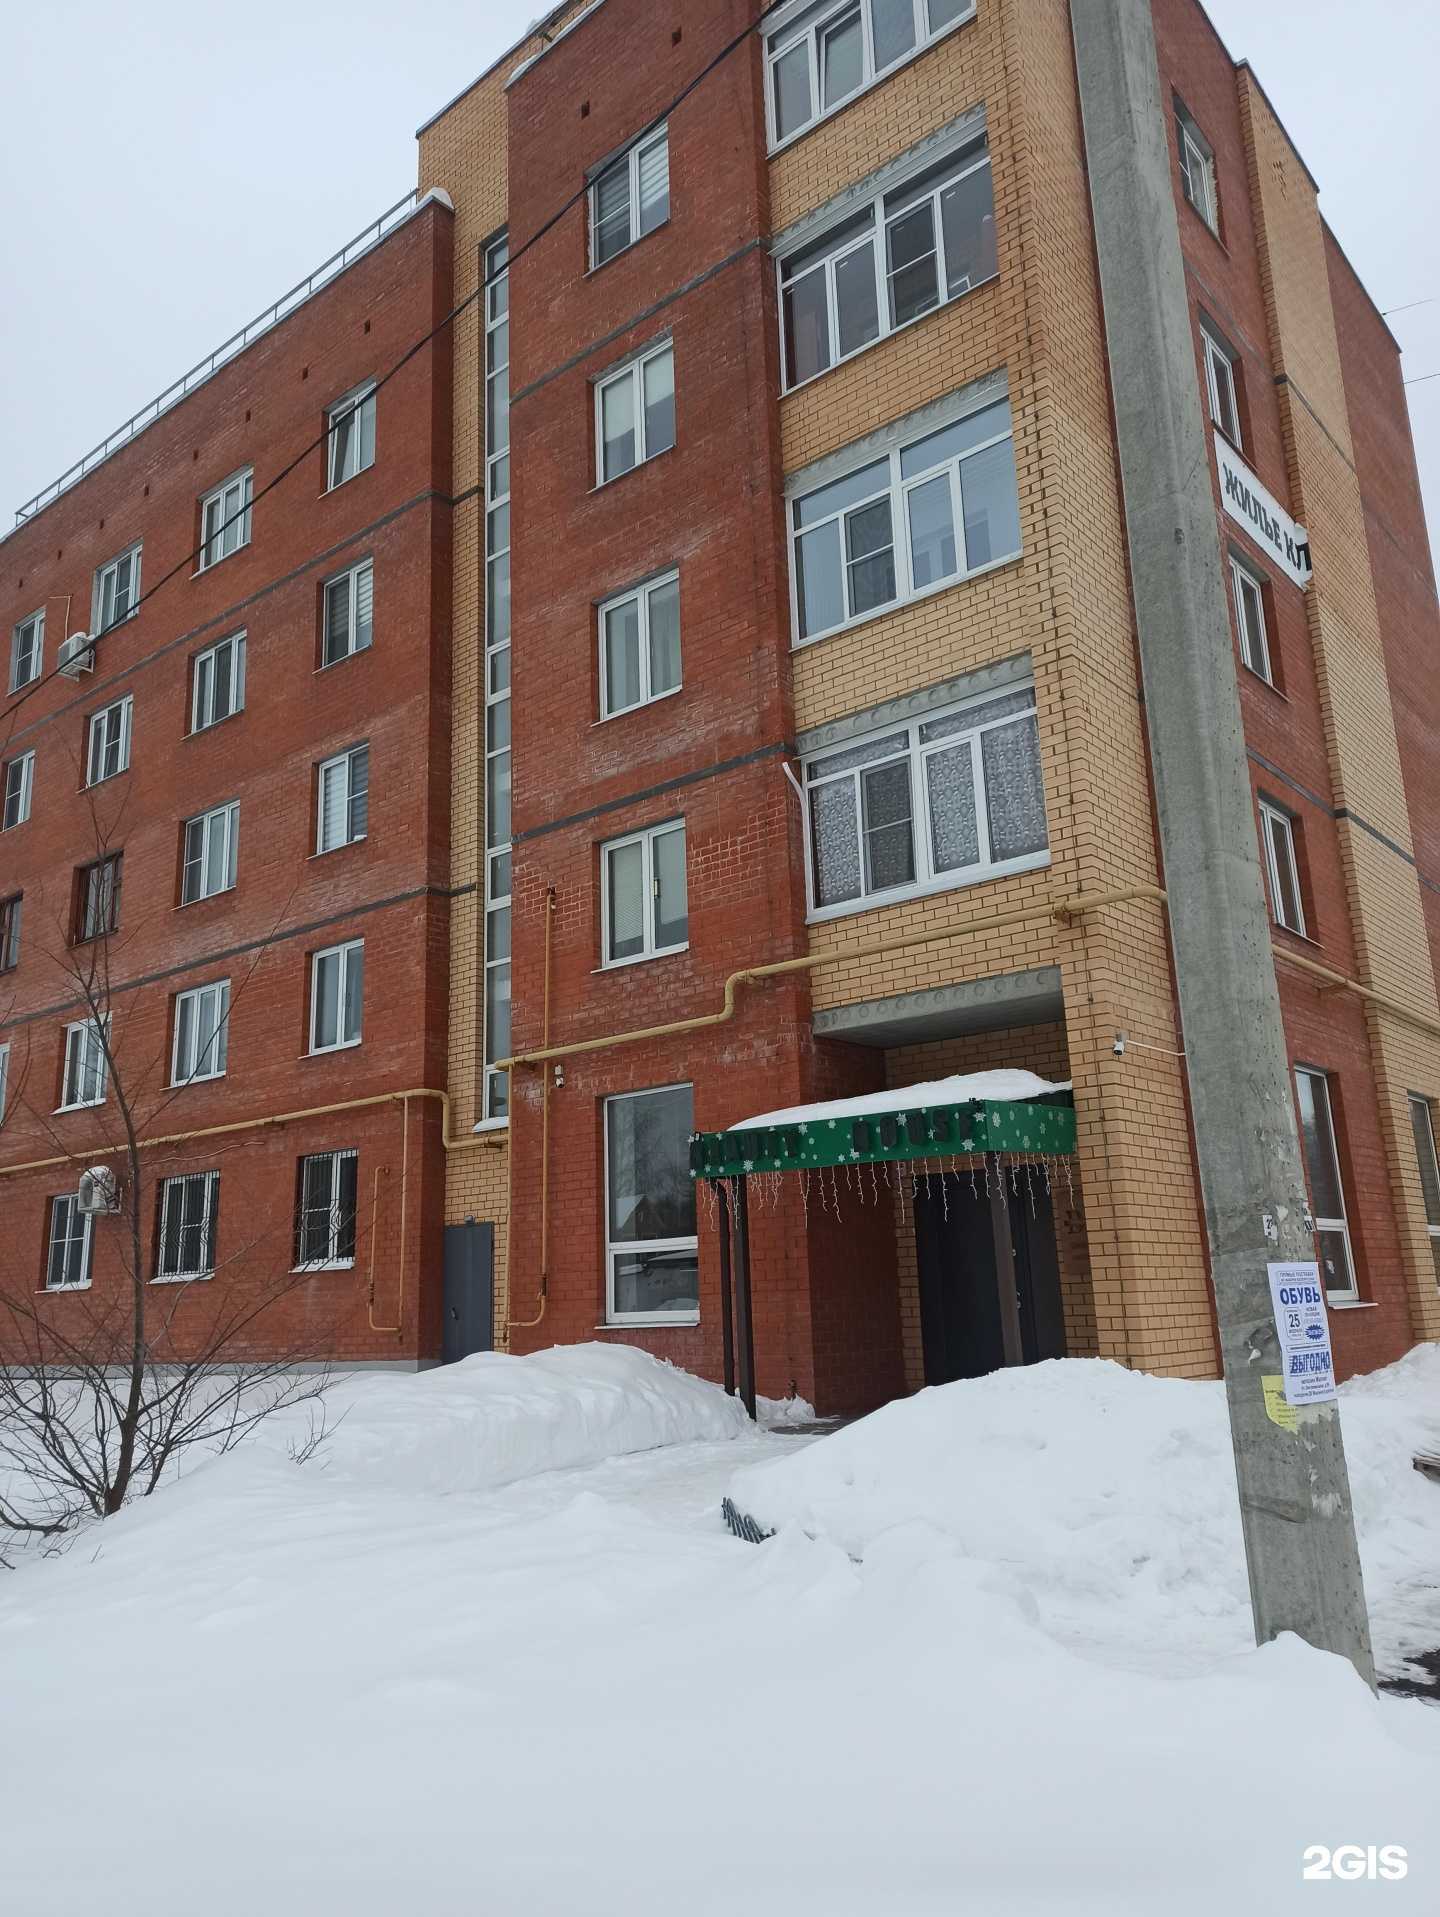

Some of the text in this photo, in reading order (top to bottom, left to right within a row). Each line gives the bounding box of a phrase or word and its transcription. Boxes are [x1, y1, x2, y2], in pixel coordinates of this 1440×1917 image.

[1222, 461, 1283, 552] ЖИЛЬЕ
[1279, 1286, 1321, 1305] ОБУВЬ
[1288, 1313, 1301, 1329] 25
[1289, 1351, 1331, 1374] ВЫГОДНО
